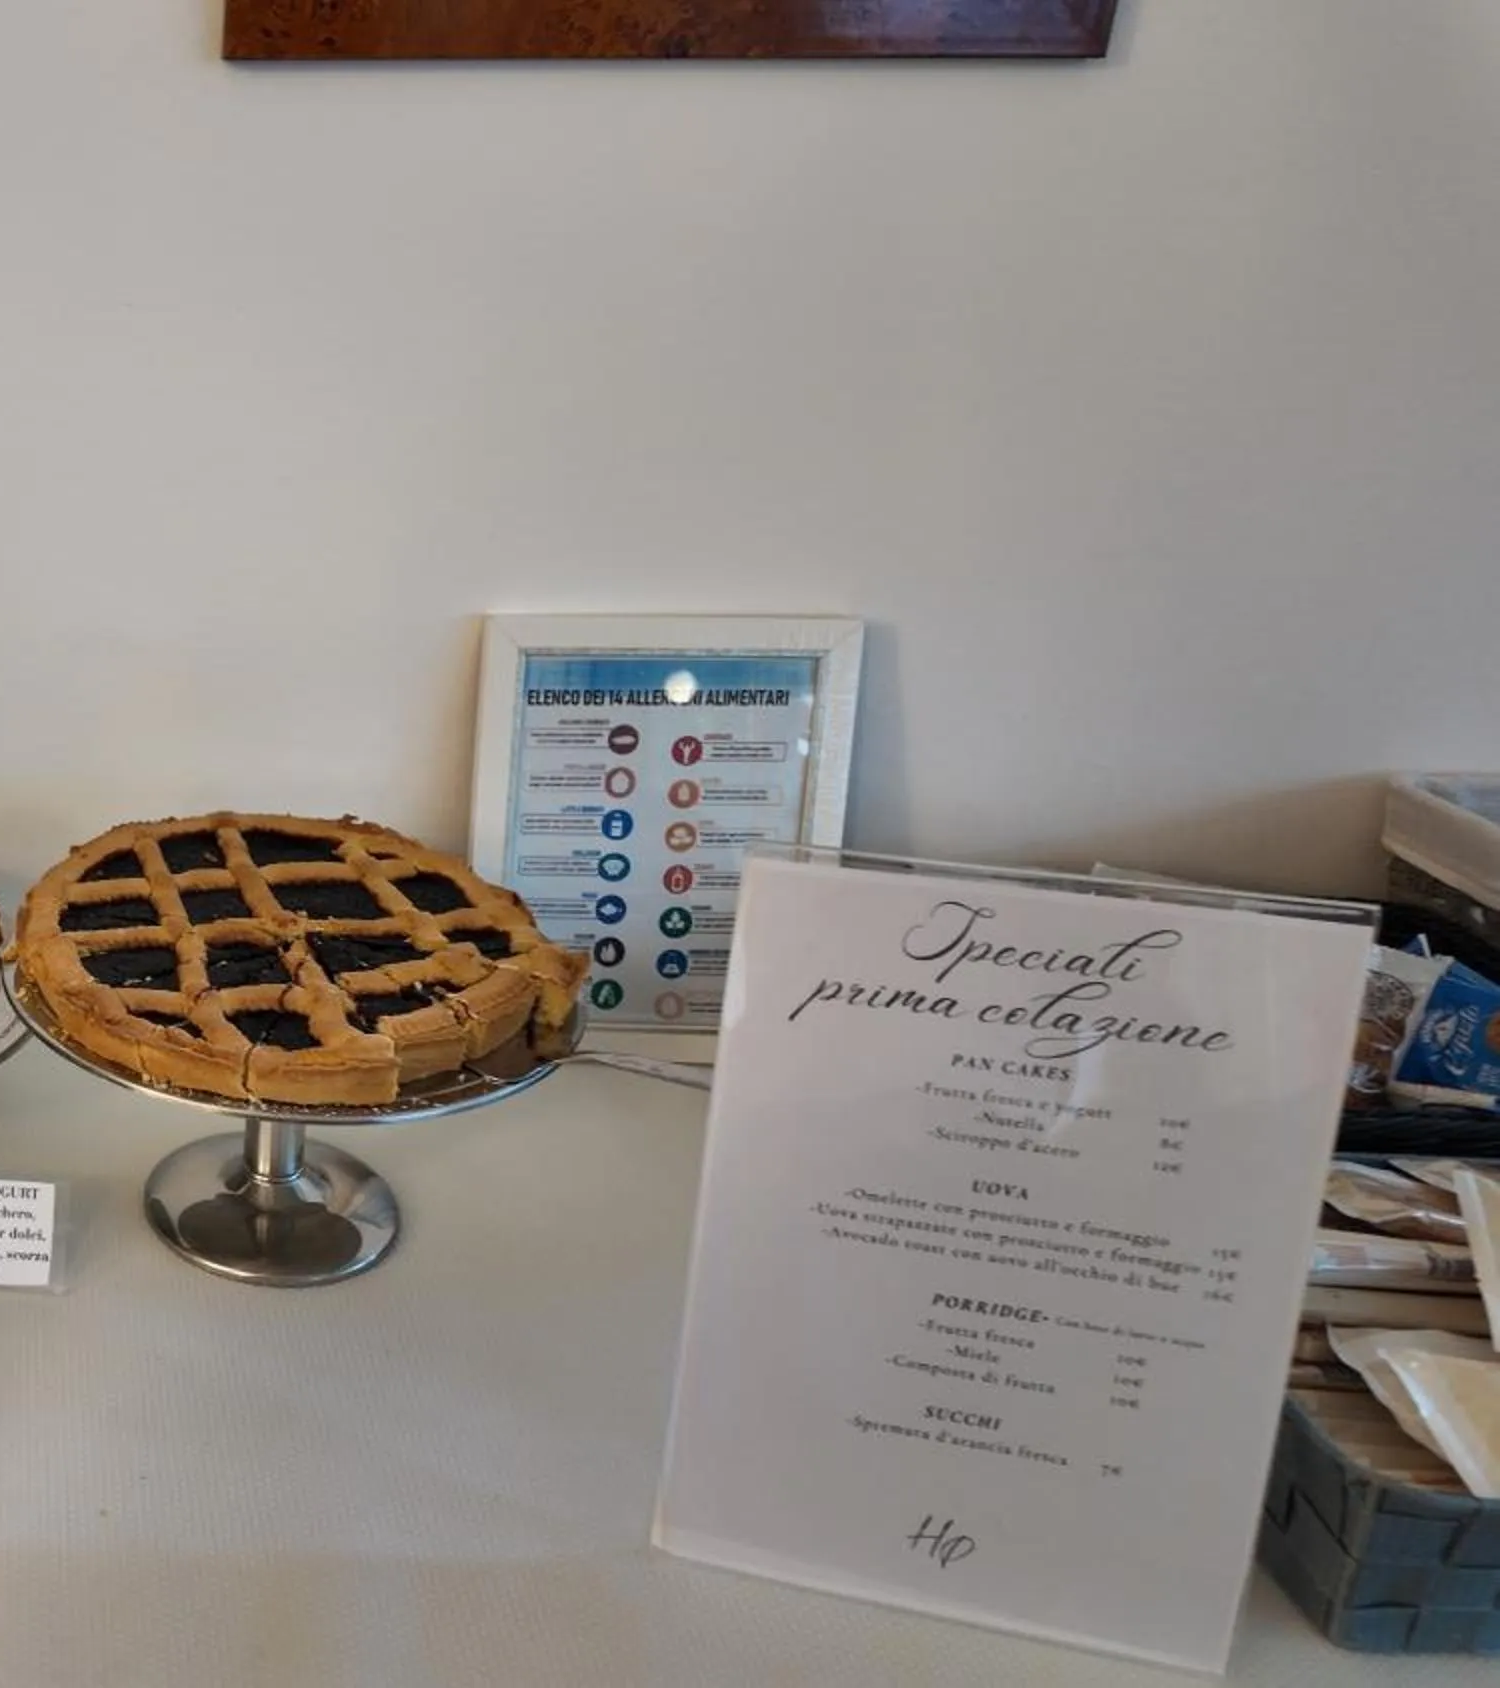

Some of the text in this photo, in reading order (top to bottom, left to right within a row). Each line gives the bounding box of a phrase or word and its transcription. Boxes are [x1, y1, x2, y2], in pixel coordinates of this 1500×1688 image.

[527, 688, 582, 707] ELENCO
[583, 688, 605, 706] DEI
[607, 688, 624, 706] 14
[707, 687, 790, 707] ALIMENTARI
[901, 900, 1183, 983] Speciali
[788, 973, 1236, 1060] prima colazione
[950, 1053, 1074, 1083] PAN CAKES
[982, 1087, 1034, 1110] fresca
[971, 1178, 1029, 1201] UOVA
[7, 1224, 48, 1243] dolci,
[933, 1202, 964, 1216] con
[968, 1207, 1059, 1230] prosciutto
[1079, 1219, 1171, 1248] formaggio
[6, 1250, 50, 1263] scorza
[862, 1212, 958, 1236] strapazzate
[962, 1227, 994, 1242] con
[998, 1232, 1090, 1258] prosciutto
[1109, 1246, 1202, 1276] formaggio
[903, 1239, 946, 1255] toast
[951, 1248, 982, 1261] con
[986, 1253, 1029, 1269] uovo
[1122, 1271, 1142, 1287] di
[1147, 1274, 1181, 1294] bue
[984, 1327, 1036, 1350] fresca
[980, 1371, 999, 1386] di
[1004, 1373, 1056, 1395] frutta
[923, 1404, 1004, 1432] SUCCHI
[935, 1429, 1012, 1456] d'arancia
[1016, 1444, 1069, 1467] fresca
